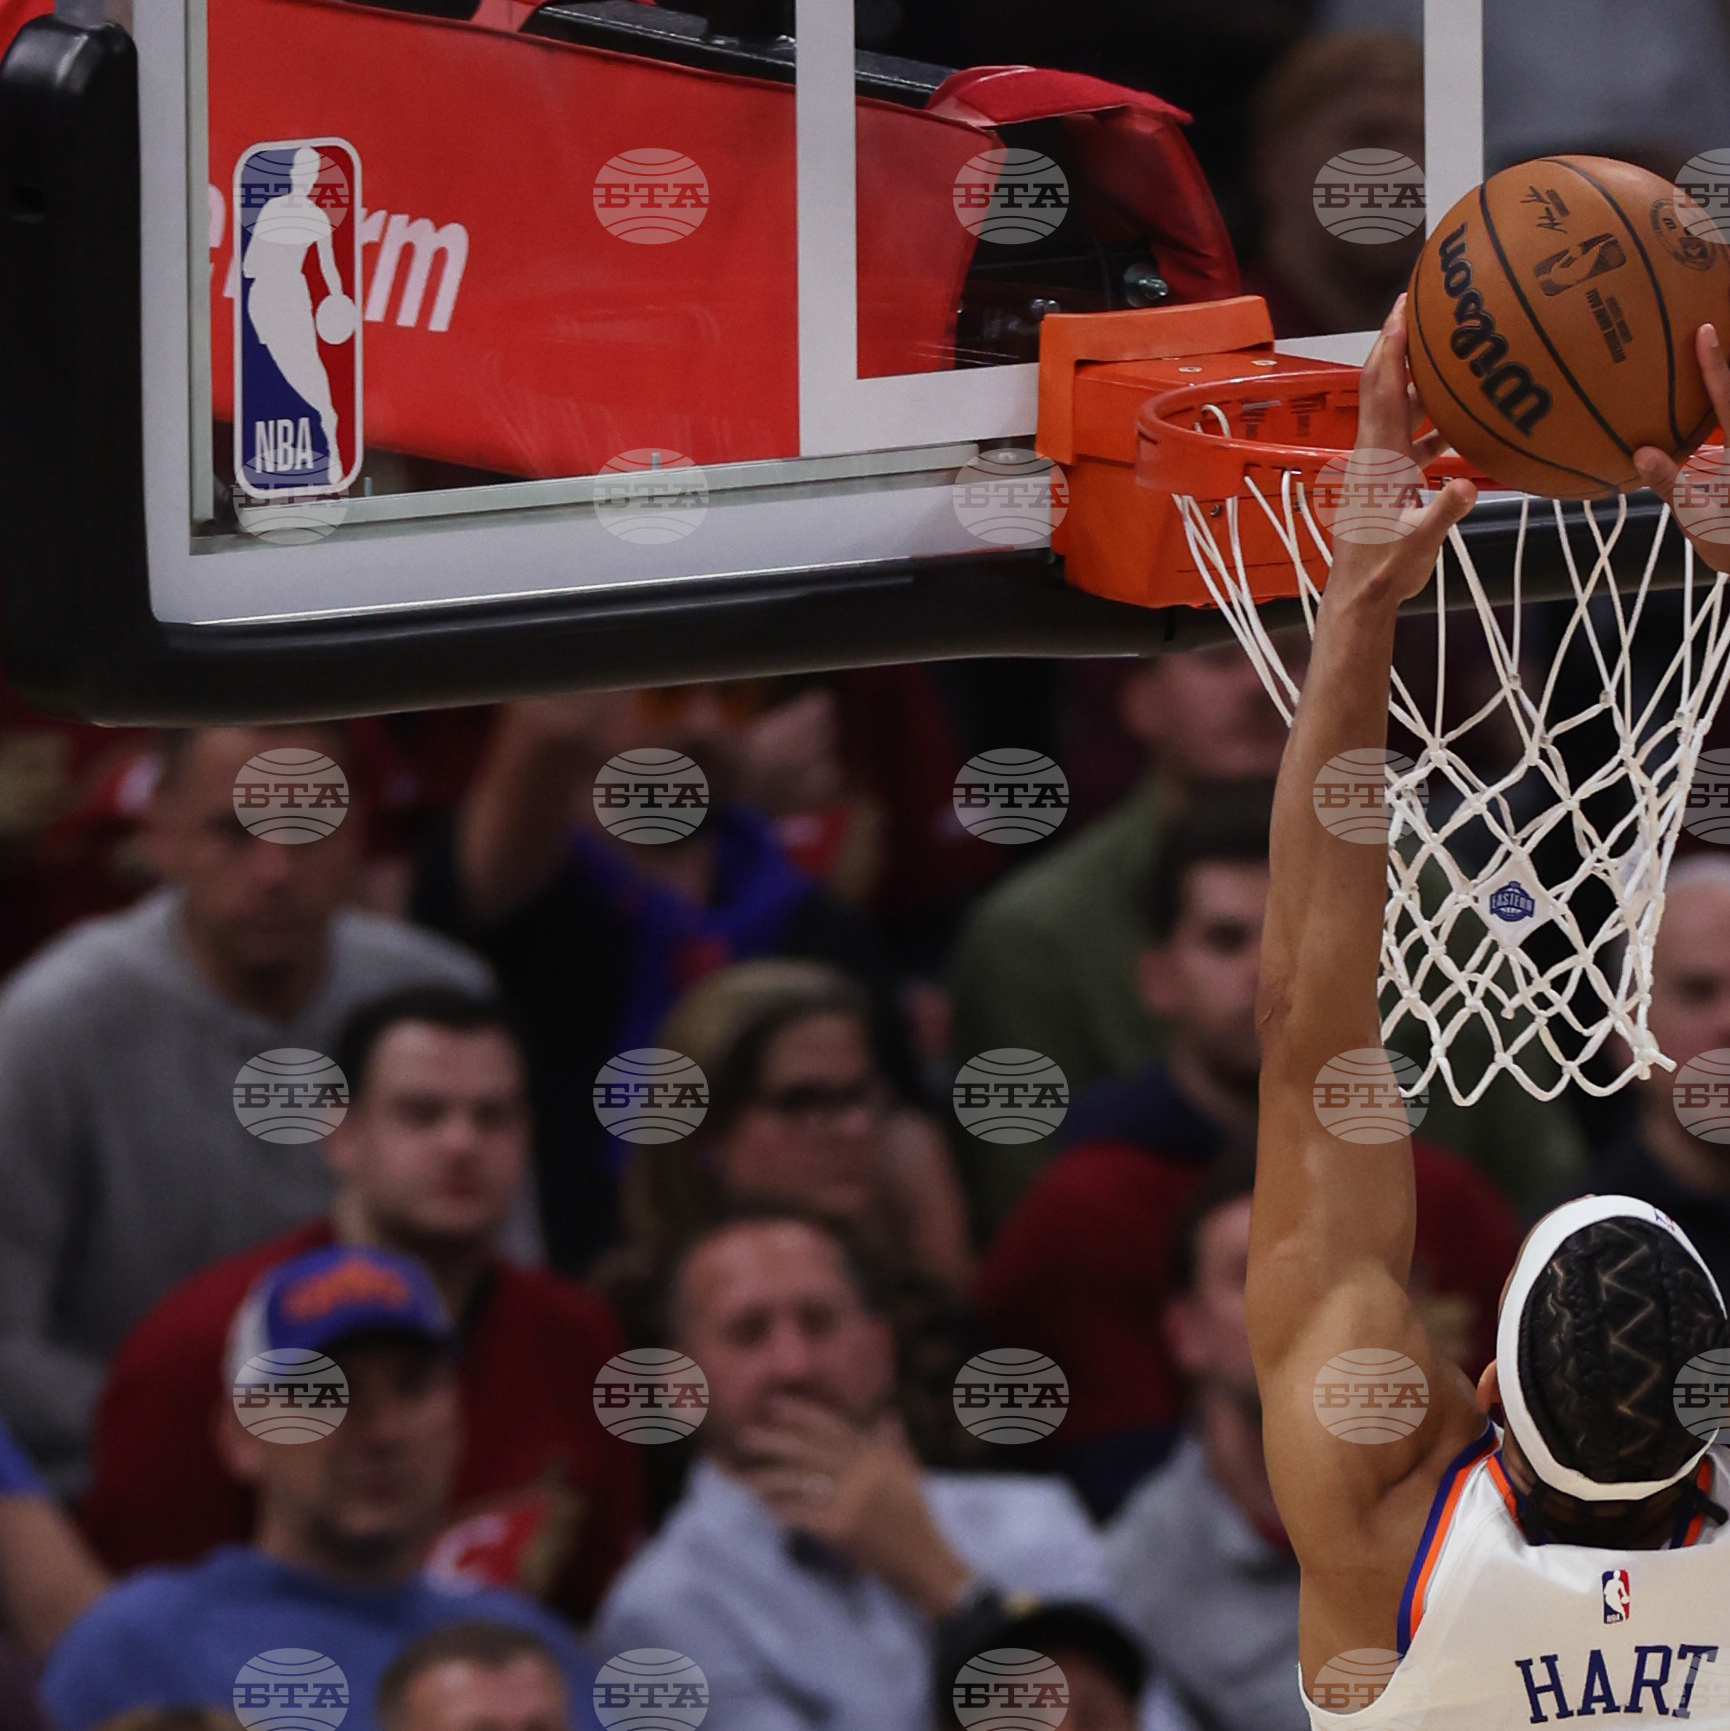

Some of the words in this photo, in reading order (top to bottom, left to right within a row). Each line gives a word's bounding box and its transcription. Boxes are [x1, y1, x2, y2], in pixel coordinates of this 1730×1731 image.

[1439, 222, 1553, 438] Wilson
[255, 417, 313, 473] NBA
[1515, 1644, 1719, 1724] HART
